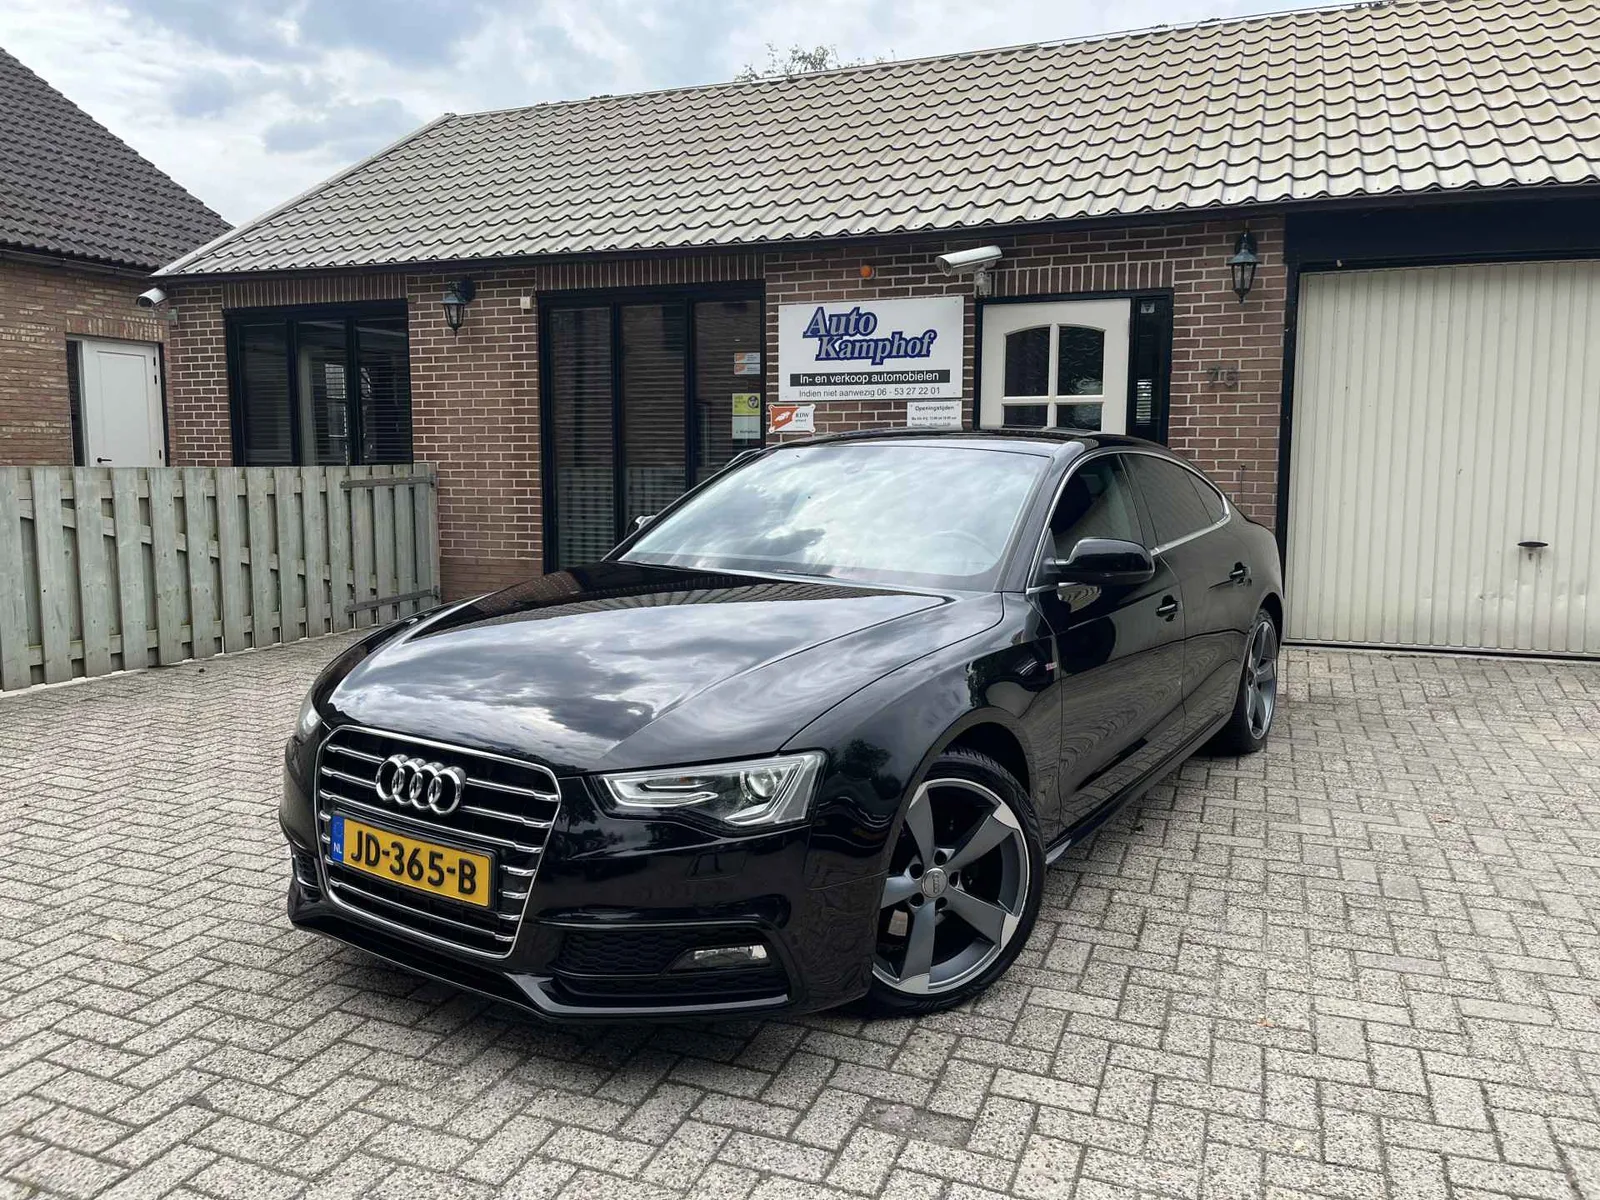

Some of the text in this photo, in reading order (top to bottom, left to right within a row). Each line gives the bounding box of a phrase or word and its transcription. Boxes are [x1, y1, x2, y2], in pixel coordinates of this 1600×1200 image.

[802, 306, 878, 338] Auto
[815, 329, 937, 366] Kamphof
[800, 371, 939, 385] In- en verkoop automobielen
[799, 389, 821, 398] Indien
[823, 389, 837, 397] niet
[839, 388, 875, 398] aanwezig
[876, 387, 887, 396] 06
[894, 387, 905, 396] 53
[906, 387, 917, 395] 27
[918, 386, 929, 395] 22
[930, 386, 940, 395] 01
[333, 842, 343, 854] NL
[350, 830, 477, 895] JD-365-B
